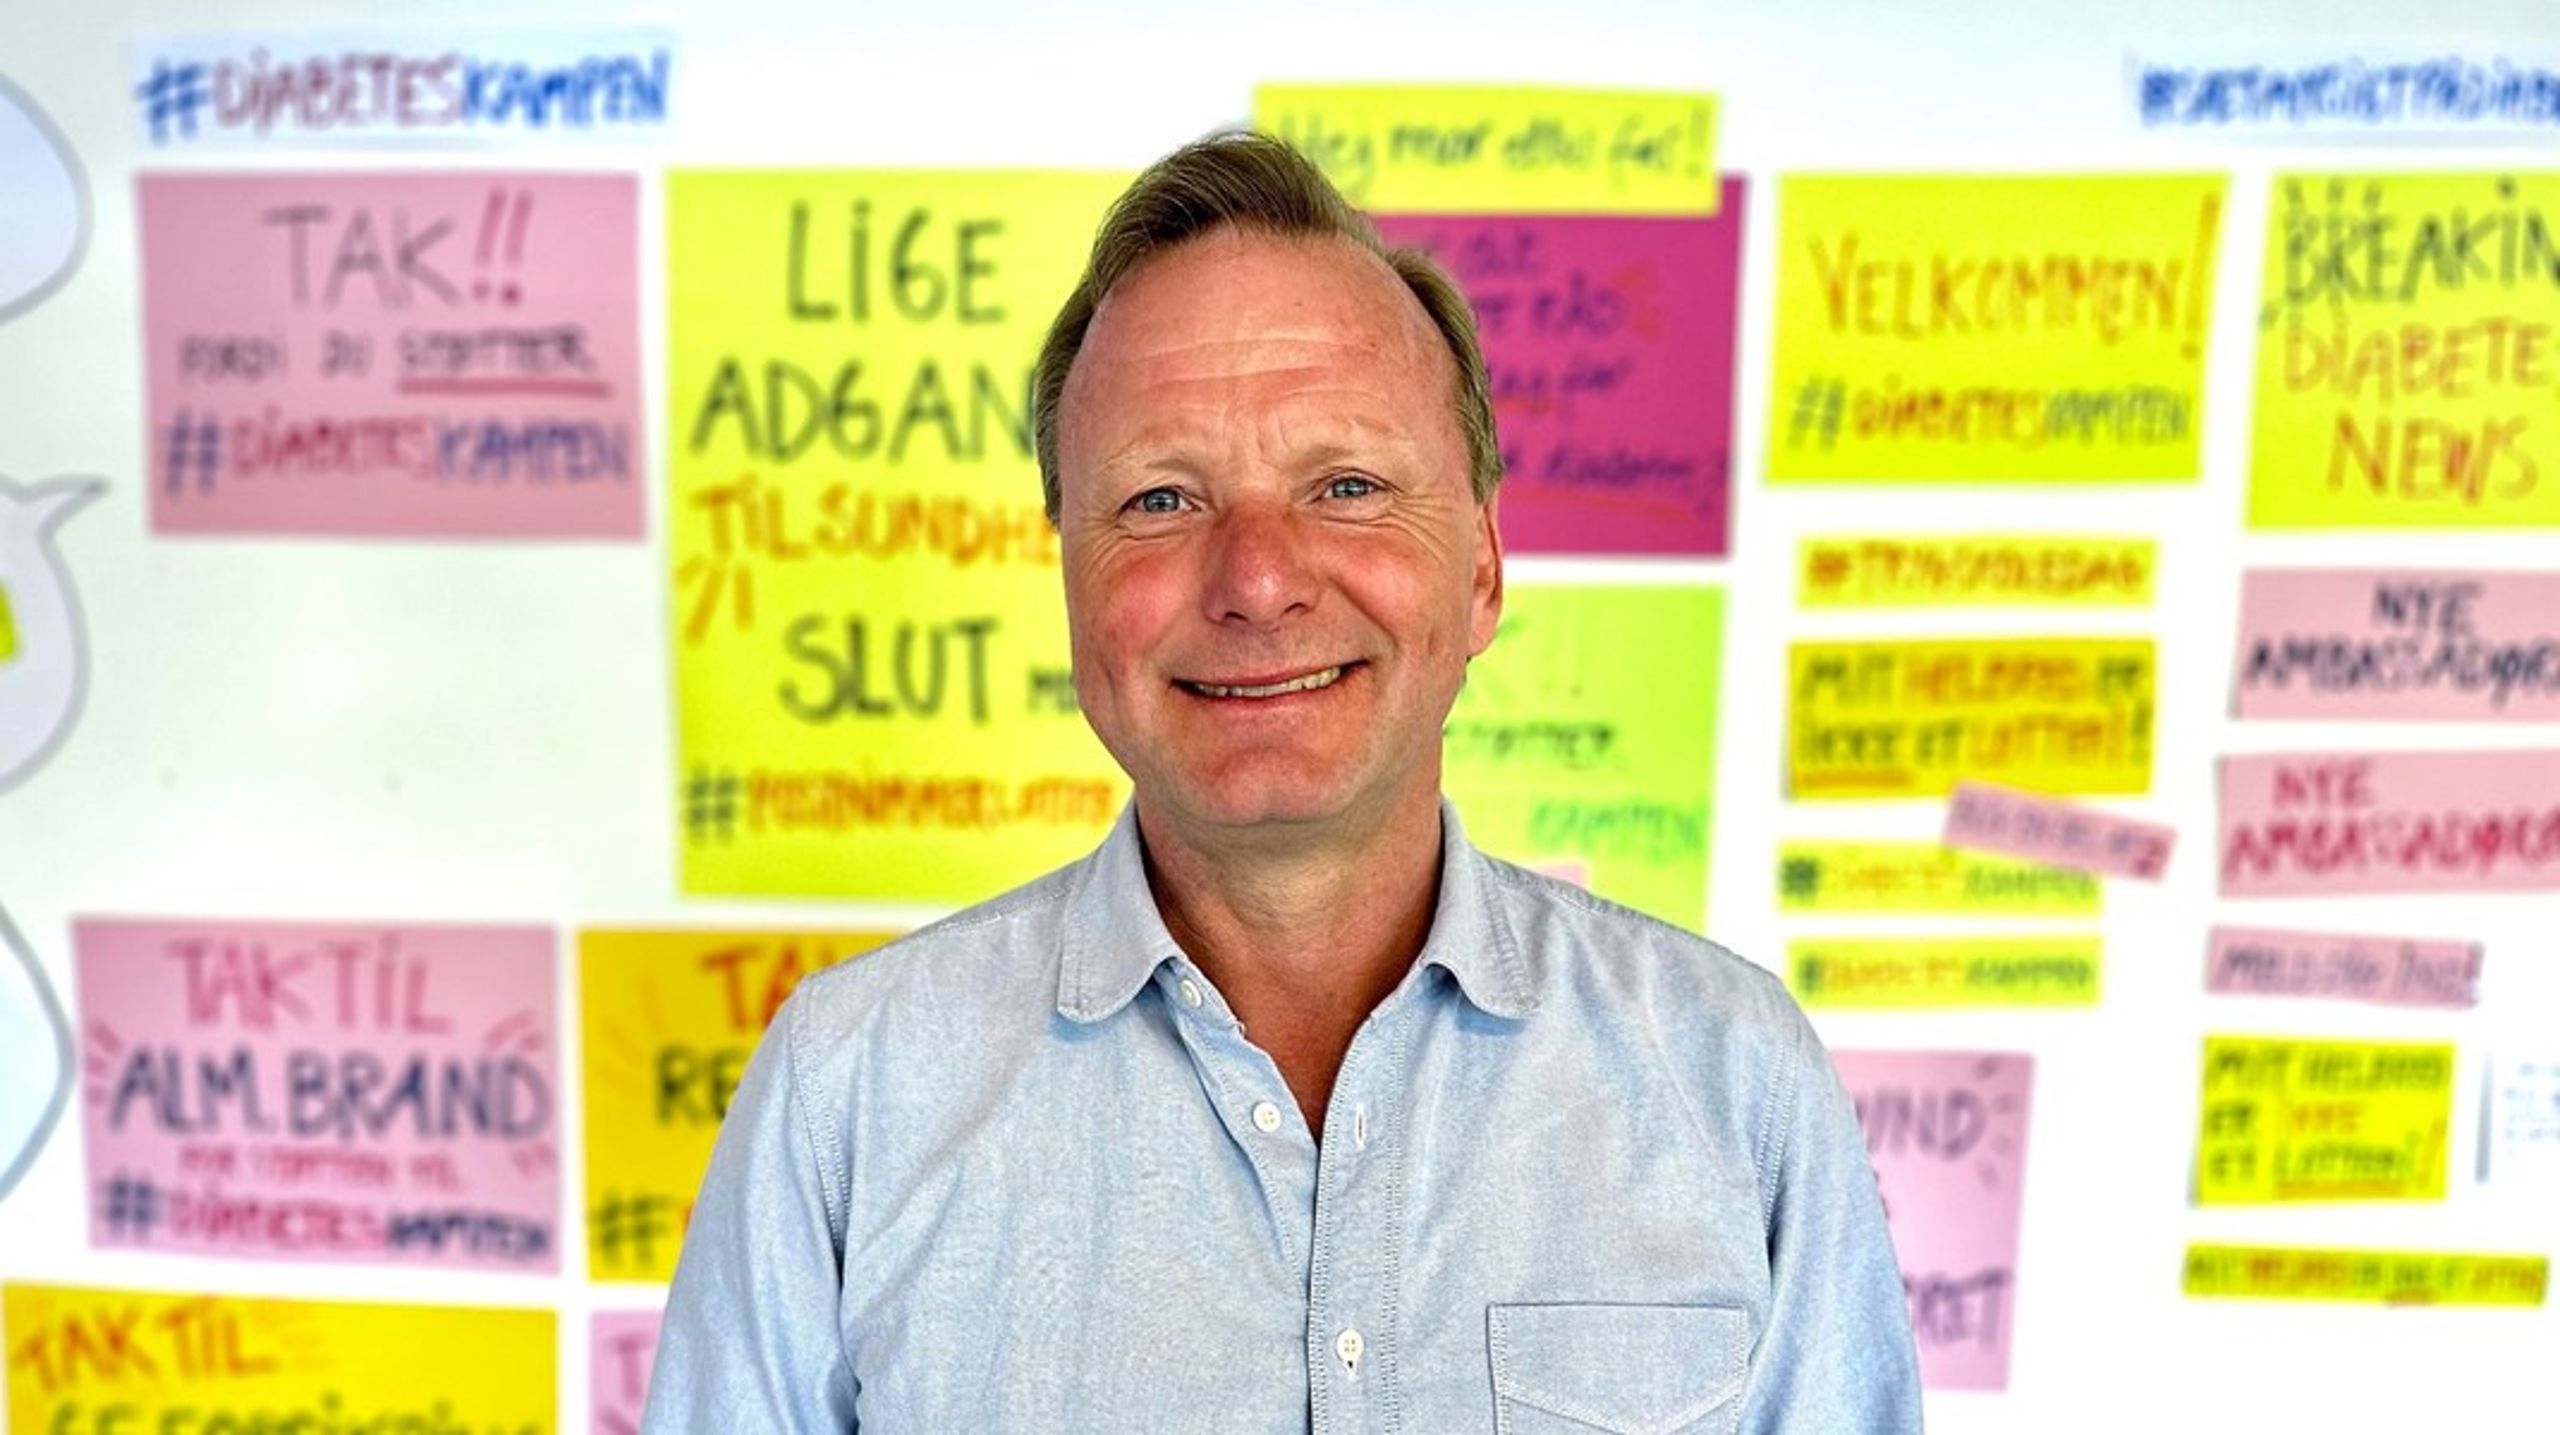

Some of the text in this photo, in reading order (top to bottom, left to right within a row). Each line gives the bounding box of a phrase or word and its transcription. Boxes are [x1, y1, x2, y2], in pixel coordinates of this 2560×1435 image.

[262, 188, 534, 307] TAK!!
[1806, 190, 2222, 362] VELKOMMEN!
[2325, 408, 2540, 507] NEWS
[777, 612, 1000, 726] SLUT
